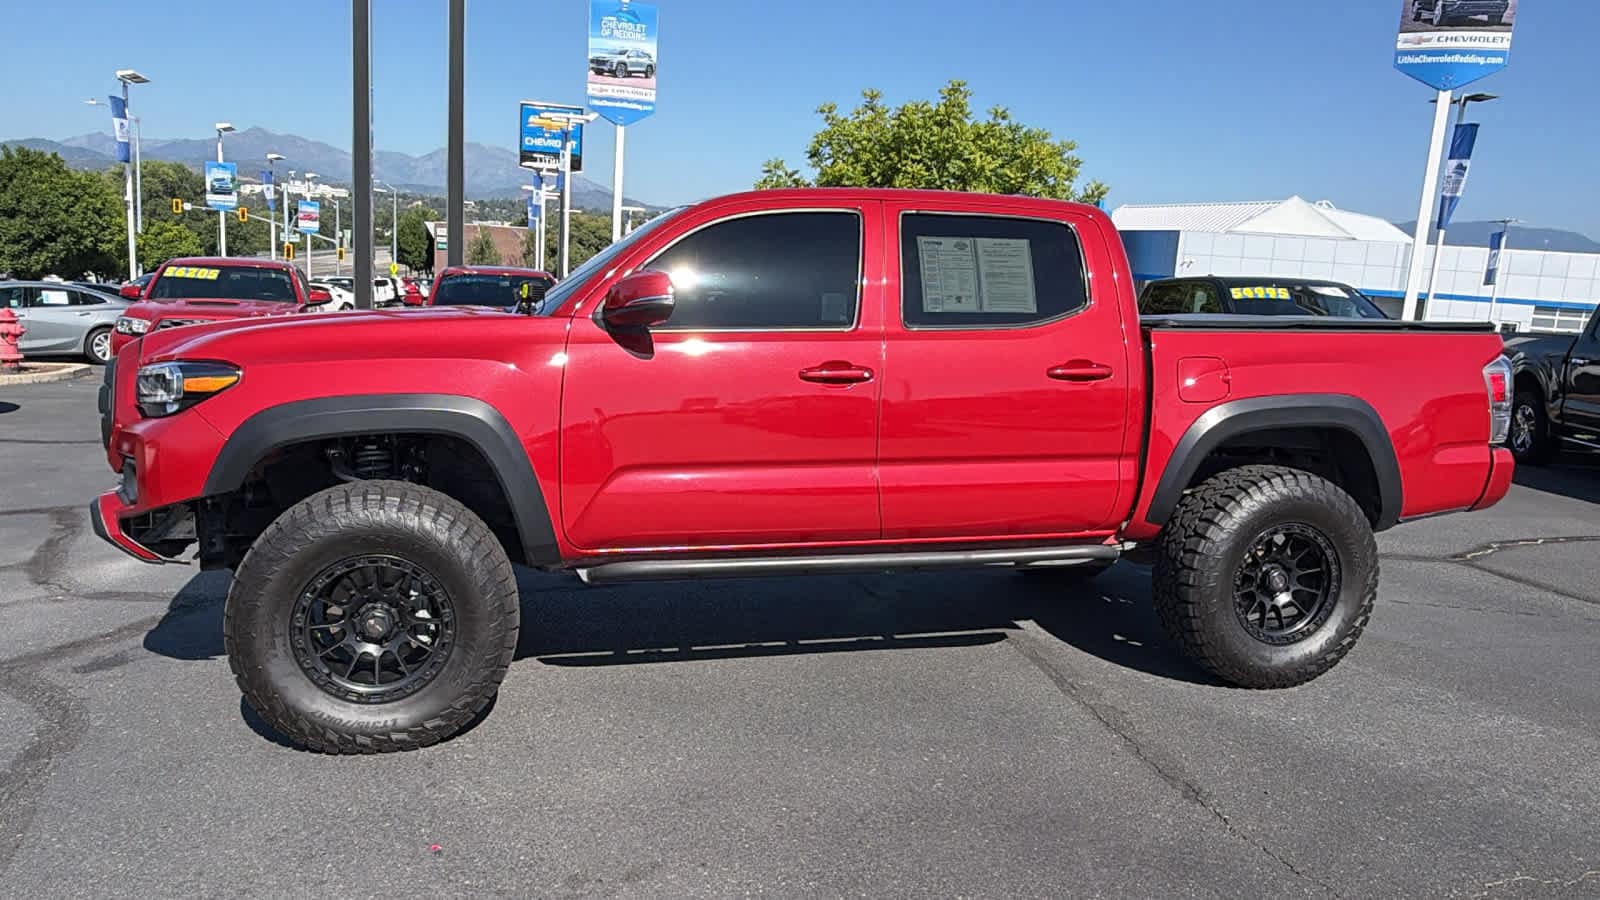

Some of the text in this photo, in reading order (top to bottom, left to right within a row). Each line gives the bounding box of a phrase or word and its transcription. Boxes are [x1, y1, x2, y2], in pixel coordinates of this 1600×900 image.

[601, 20, 647, 33] CHEVROLET
[1436, 35, 1505, 43] CHEVROLET
[1397, 54, 1503, 65] LithiaChevroletRedding.com
[525, 137, 577, 149] CHEVROT
